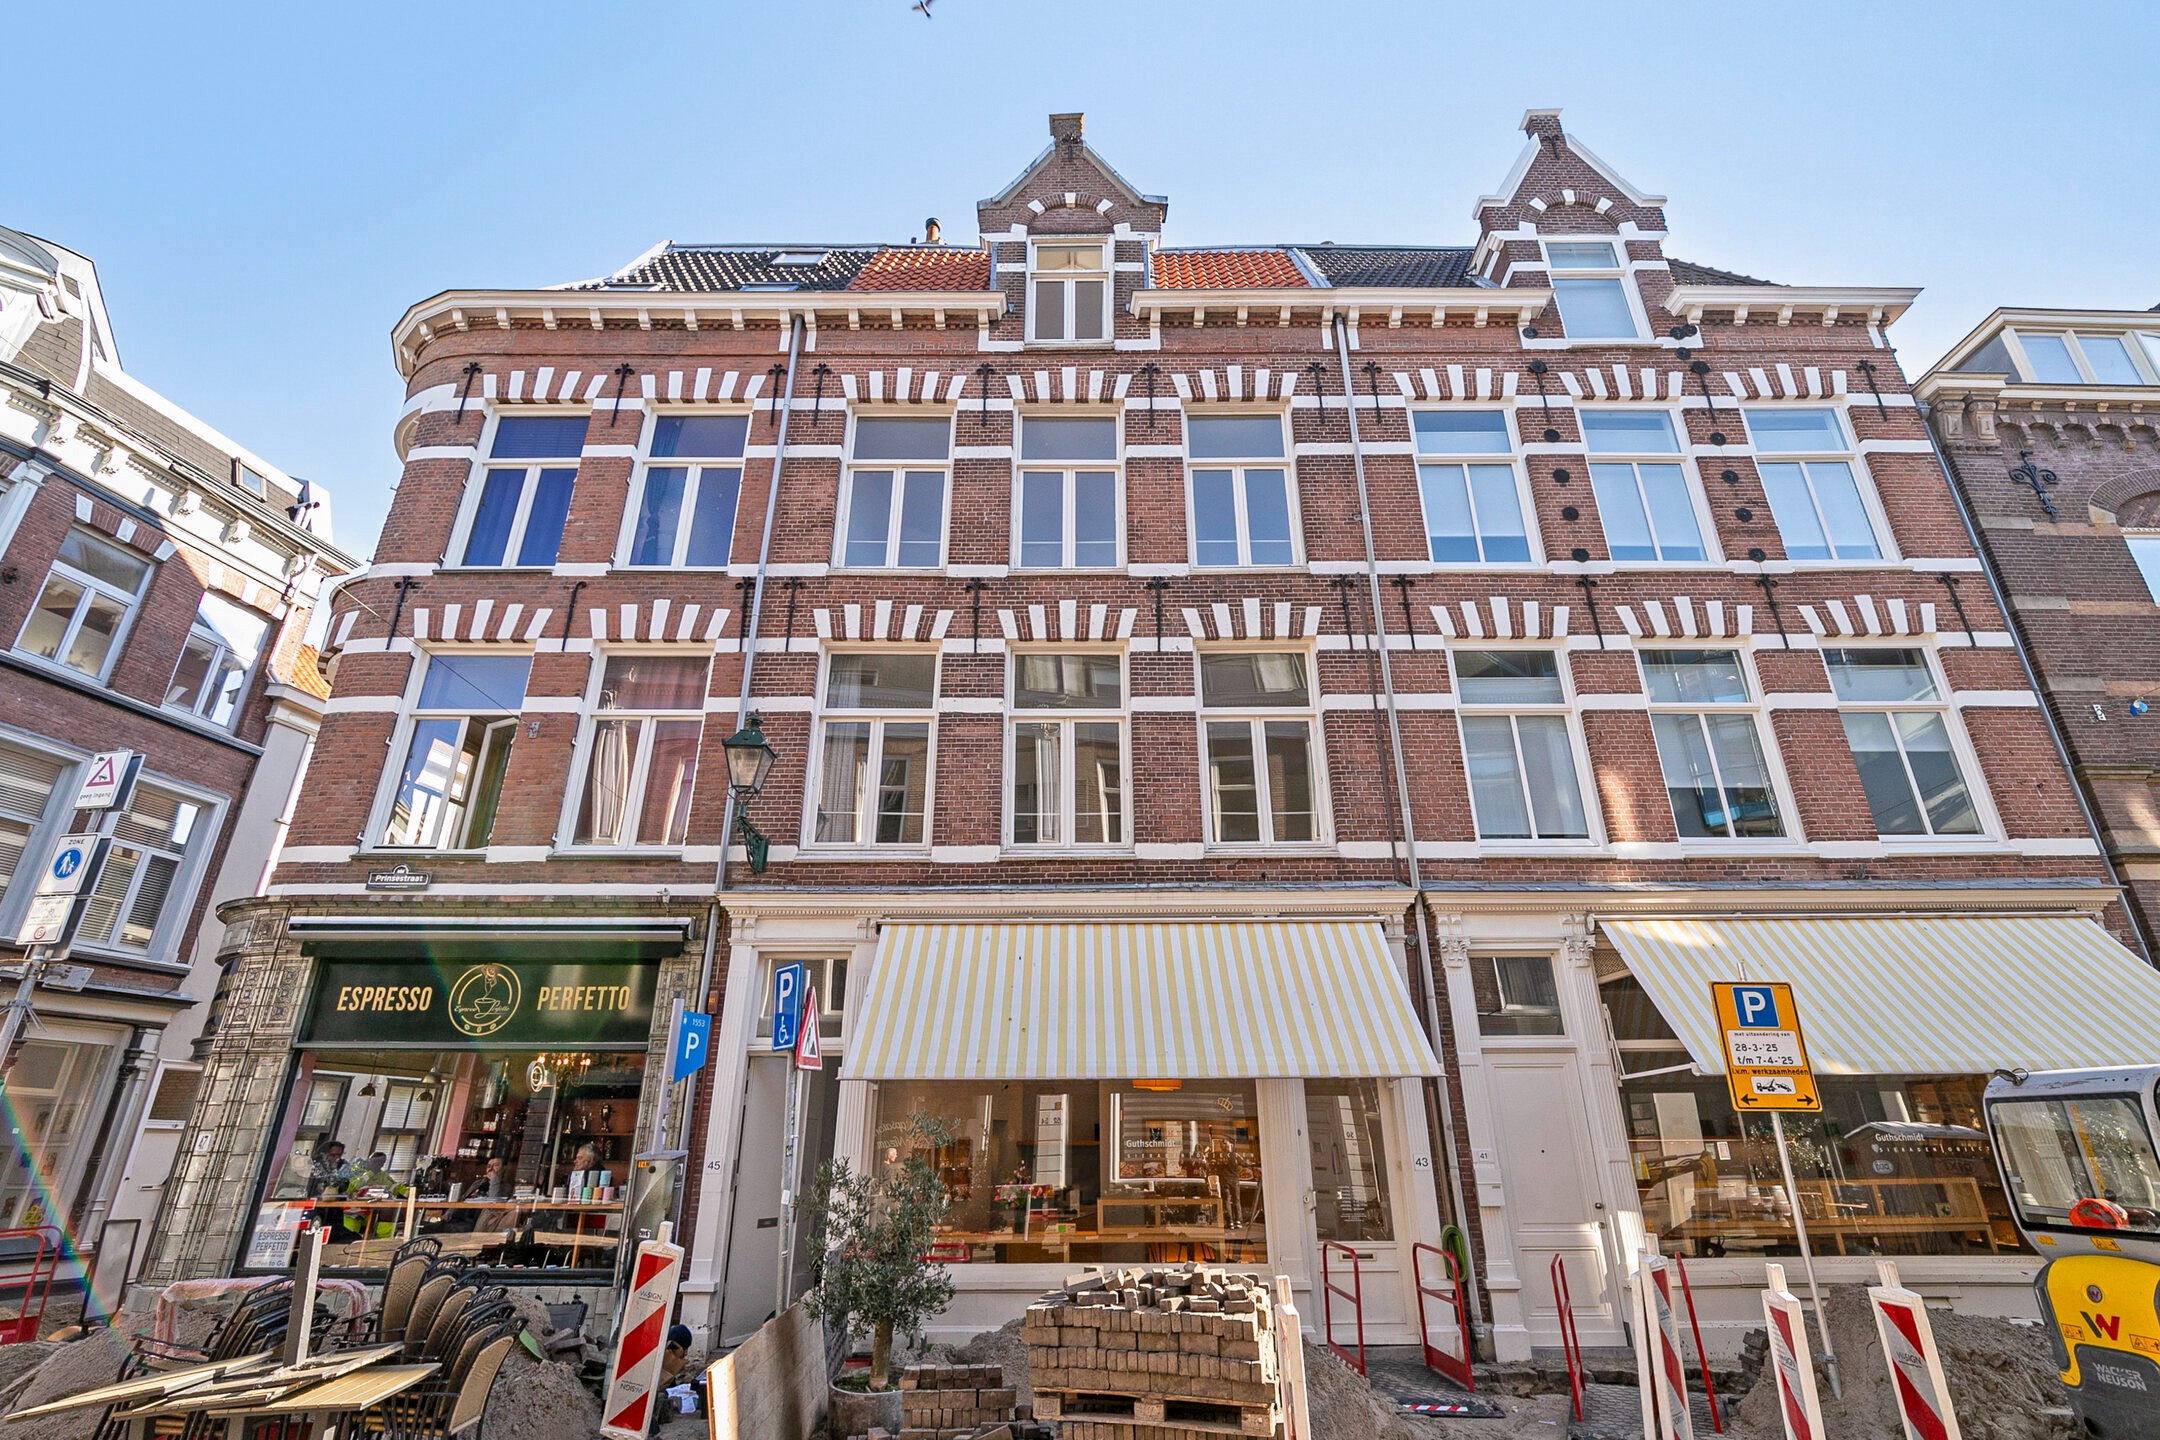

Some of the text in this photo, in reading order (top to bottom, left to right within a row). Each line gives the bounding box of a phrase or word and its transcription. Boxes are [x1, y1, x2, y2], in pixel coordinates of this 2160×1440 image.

[374, 873, 424, 882] Prinsestraat
[779, 972, 794, 1013] P
[337, 986, 433, 1011] ESPRESSO
[536, 985, 632, 1011] PERFETTO
[1741, 991, 1766, 1023] P
[692, 1018, 706, 1028] 1553
[685, 1032, 700, 1060] P
[1735, 1043, 1778, 1052] 28-3-'25
[1737, 1055, 1794, 1065] t/m 7-4-'25
[1752, 1067, 1809, 1075] werkzaamheden
[1875, 1132, 1926, 1142] Guthschmidt
[1126, 1139, 1176, 1148] Guthschmidt
[1479, 1152, 1488, 1160] 41
[707, 1160, 721, 1171] 45
[1415, 1157, 1429, 1167] 43
[258, 1231, 291, 1241] ESPRESSO
[255, 1241, 289, 1251] PERFETTO
[2097, 1372, 2148, 1391] NEUSON
